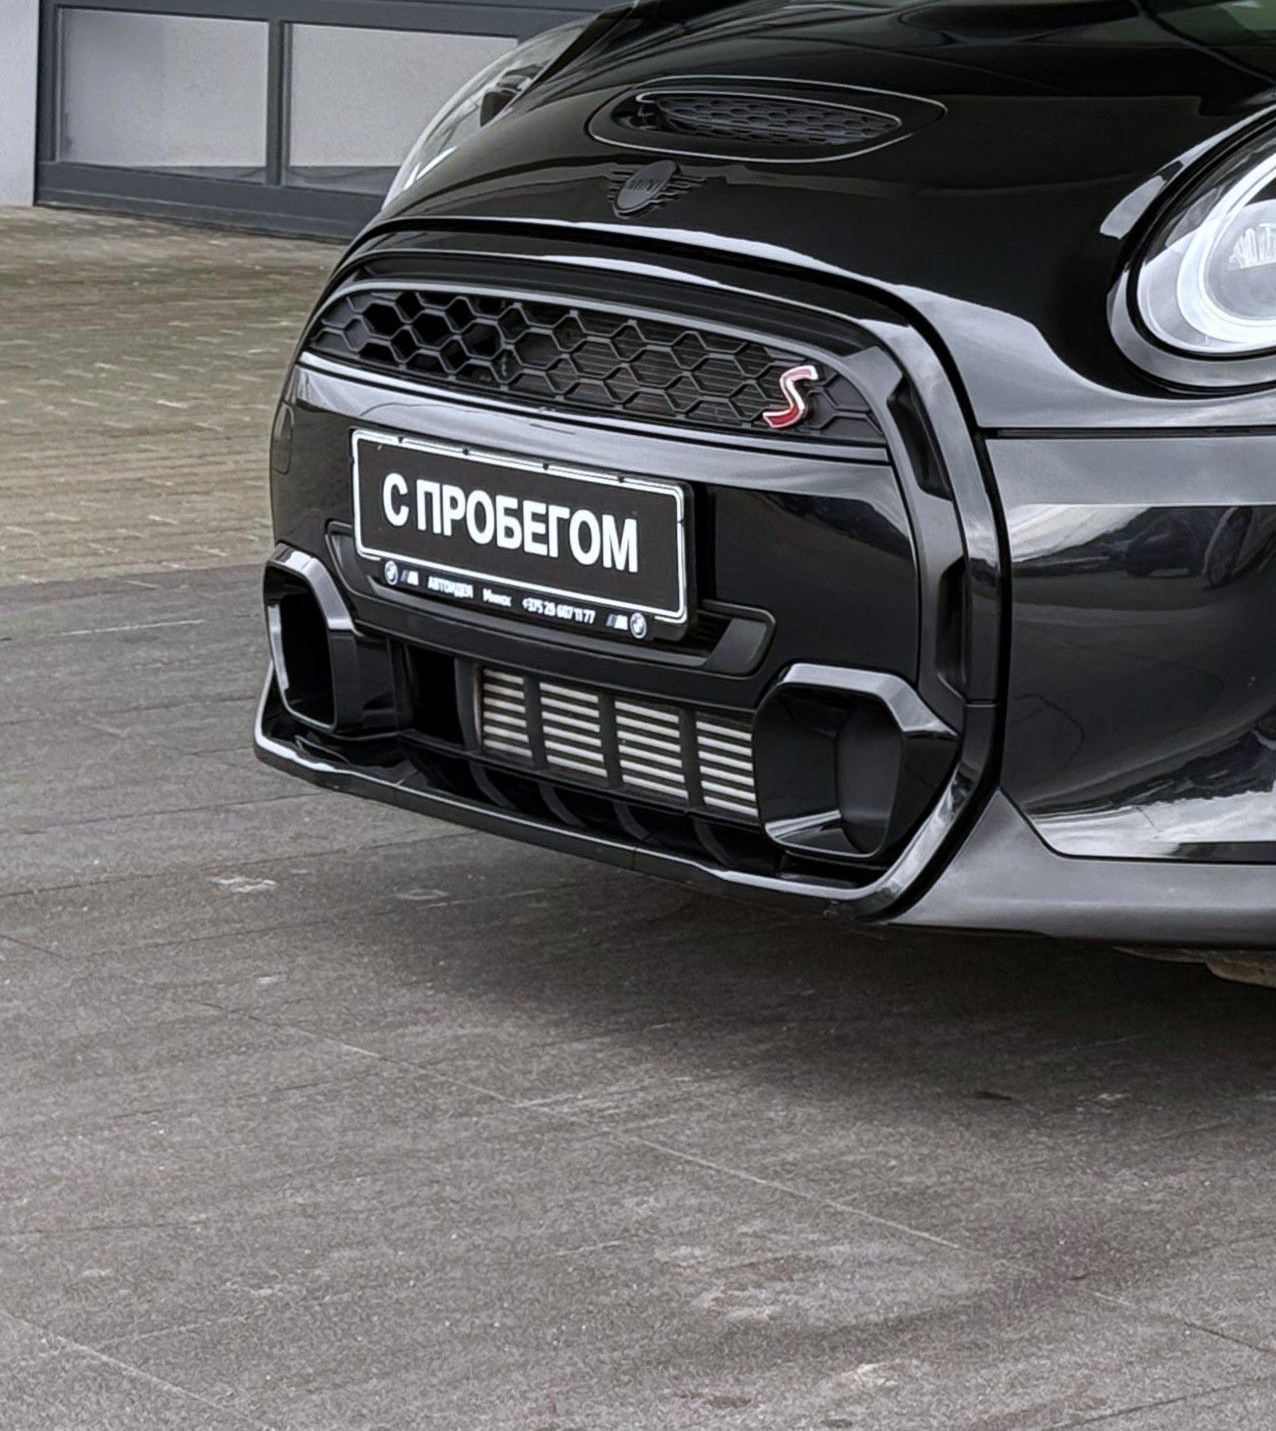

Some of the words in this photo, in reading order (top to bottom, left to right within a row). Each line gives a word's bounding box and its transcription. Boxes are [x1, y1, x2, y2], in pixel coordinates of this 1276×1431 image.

[762, 365, 819, 429] S
[382, 472, 410, 527] С
[415, 478, 638, 573] ПРОБЕГОМ
